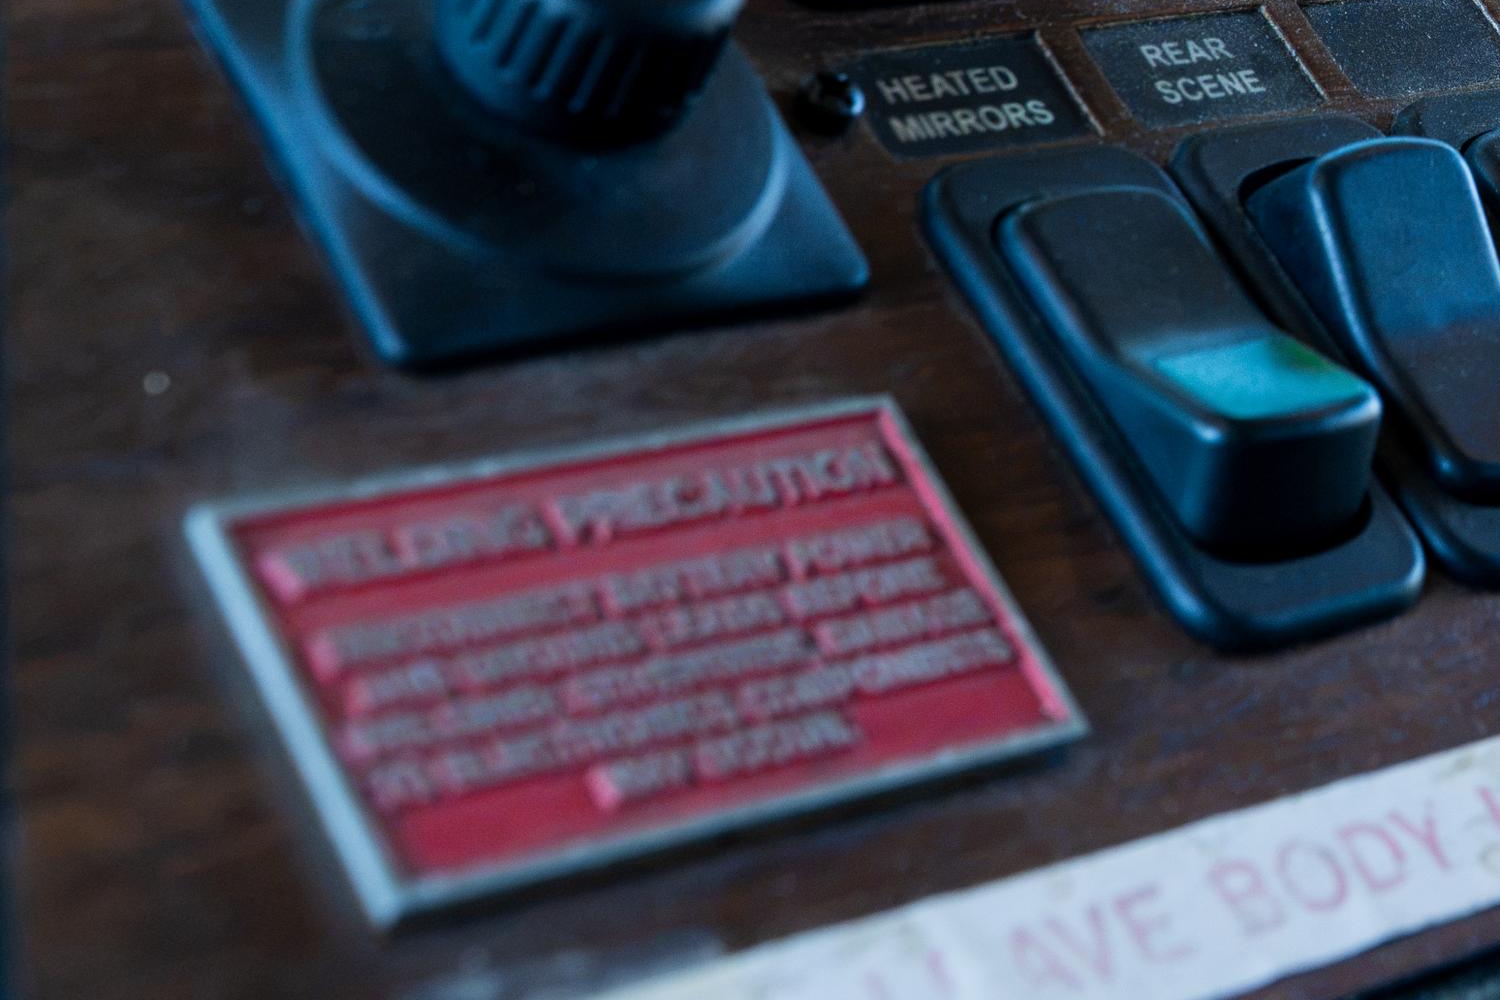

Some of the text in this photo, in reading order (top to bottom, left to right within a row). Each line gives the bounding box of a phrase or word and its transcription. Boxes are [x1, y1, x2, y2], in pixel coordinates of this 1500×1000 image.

[1140, 37, 1236, 67] REAR
[876, 65, 1019, 104] HEATED
[1155, 69, 1267, 104] SCENE
[889, 100, 1056, 144] MIRRORS
[1208, 798, 1454, 938] BODY
